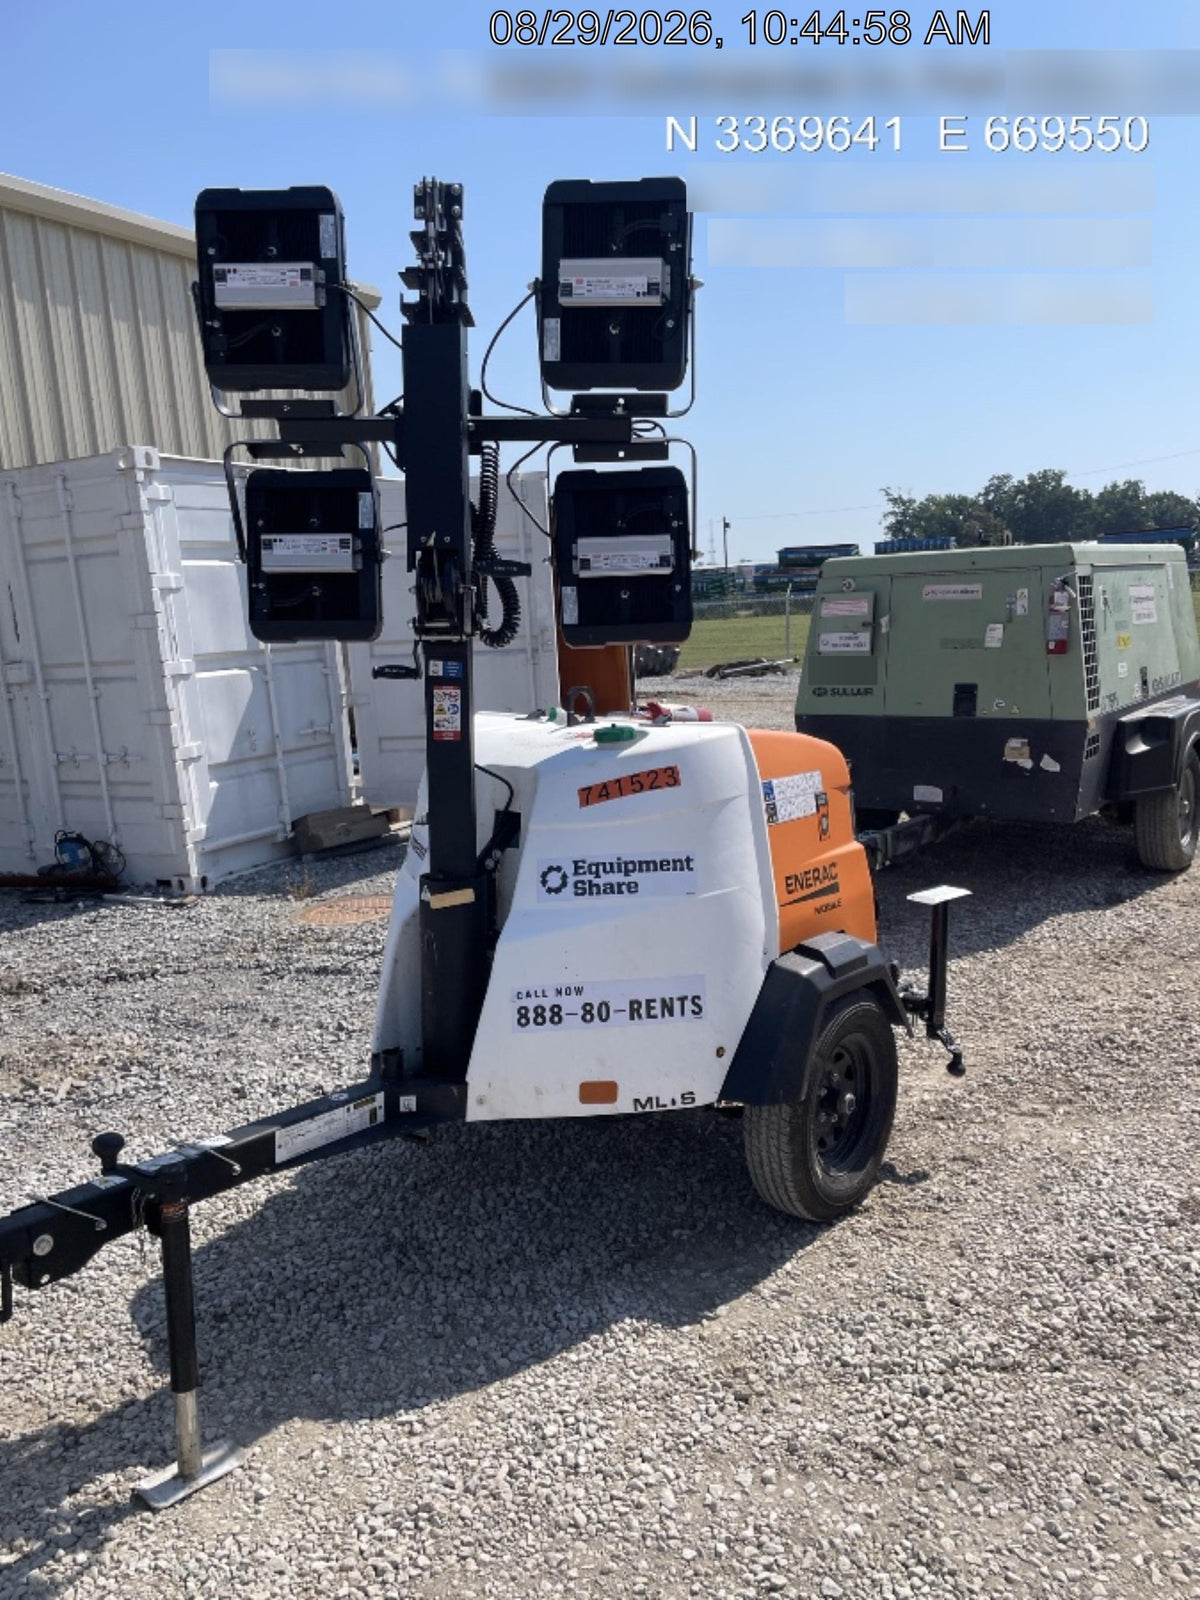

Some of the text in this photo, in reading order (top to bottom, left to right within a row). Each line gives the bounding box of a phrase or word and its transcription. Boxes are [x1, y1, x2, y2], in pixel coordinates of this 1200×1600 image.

[580, 766, 678, 806] 741523
[572, 855, 694, 879] Equipment
[573, 880, 639, 897] Share
[516, 986, 585, 1000] CALL NOW
[516, 995, 703, 1028] 888-80-RENTS
